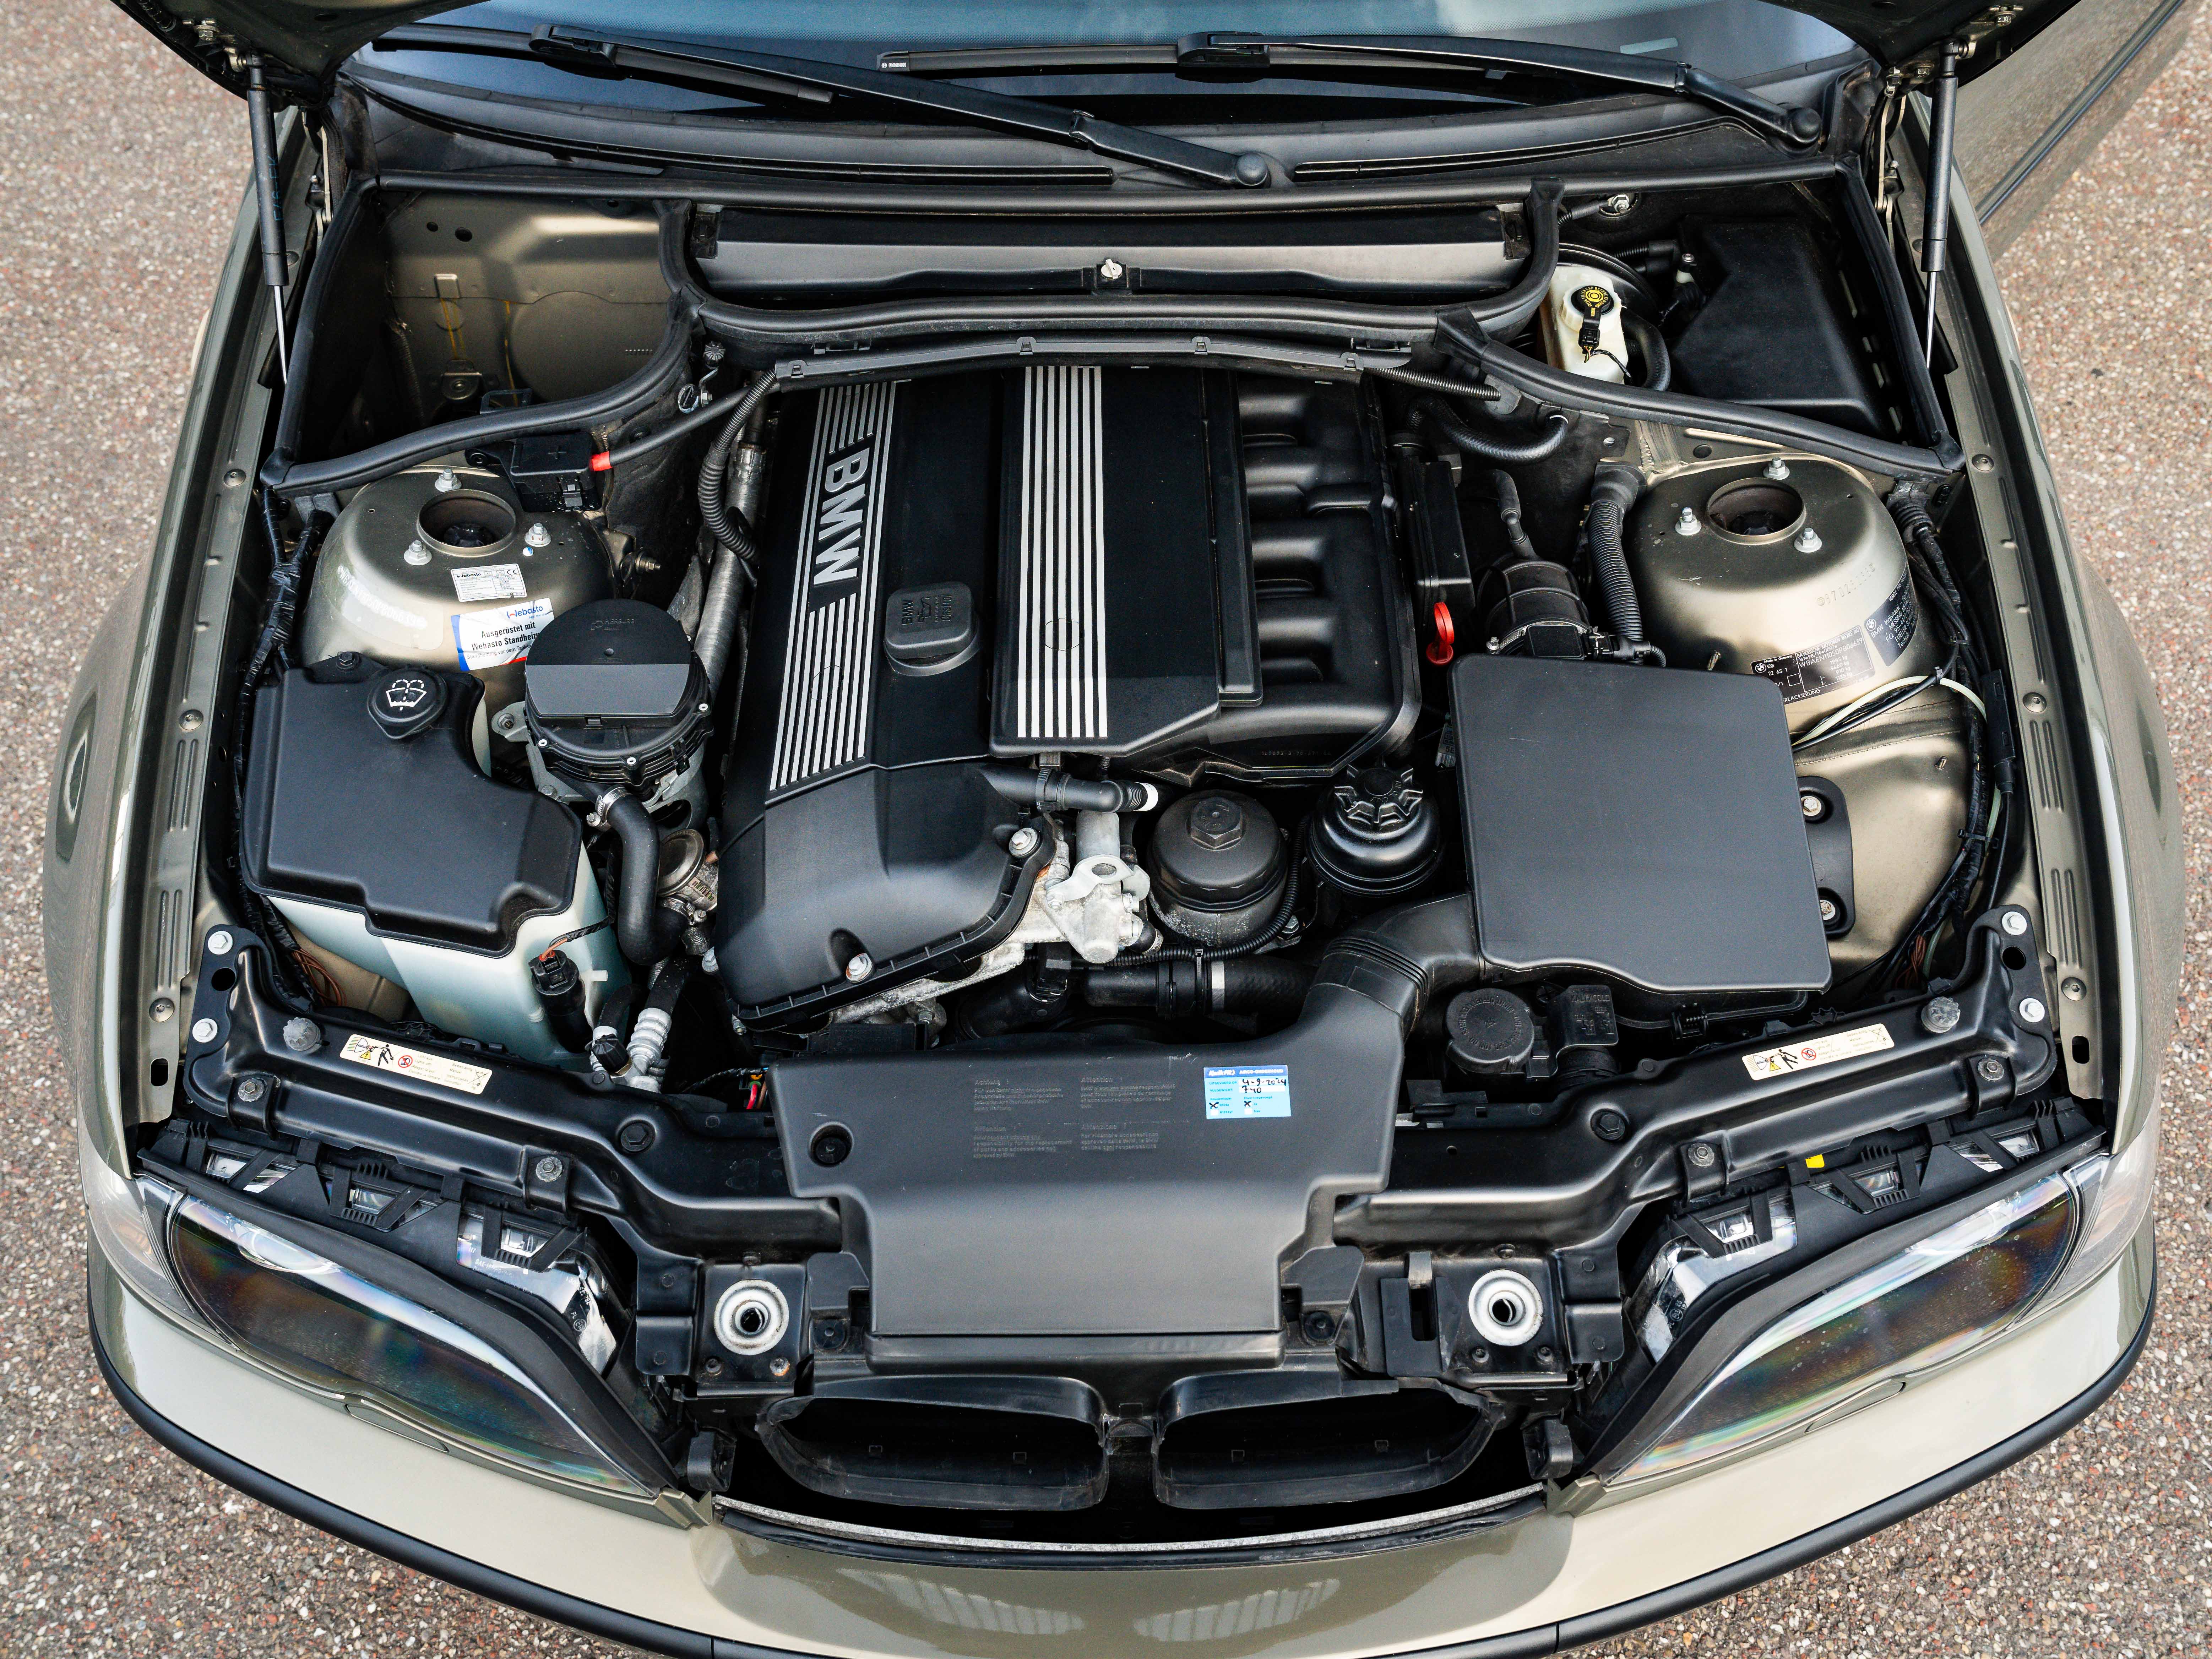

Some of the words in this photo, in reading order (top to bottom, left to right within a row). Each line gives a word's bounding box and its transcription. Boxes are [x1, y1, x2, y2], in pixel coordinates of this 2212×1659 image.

[1594, 287, 1608, 296] BEFORE
[814, 447, 870, 585] BMW
[506, 605, 543, 619] Webasto
[901, 600, 913, 625] BMW
[941, 595, 952, 621] Castrol
[1870, 625, 1884, 638] BMW
[1884, 604, 1900, 626] Individual
[1888, 611, 1903, 630] MESSING
[482, 624, 524, 639] Ausgerüstet
[525, 621, 536, 630] mit
[1895, 625, 1908, 642] FUELLER
[471, 640, 502, 651] Webasto
[1797, 646, 1821, 658] BAYERISCHE
[1821, 638, 1841, 648] MOTOREN
[1799, 638, 1863, 668] WBAEN11050PB06639
[467, 651, 497, 659] Standheizung
[1830, 657, 1842, 665] 1985
[570, 1311, 576, 1319] PL
